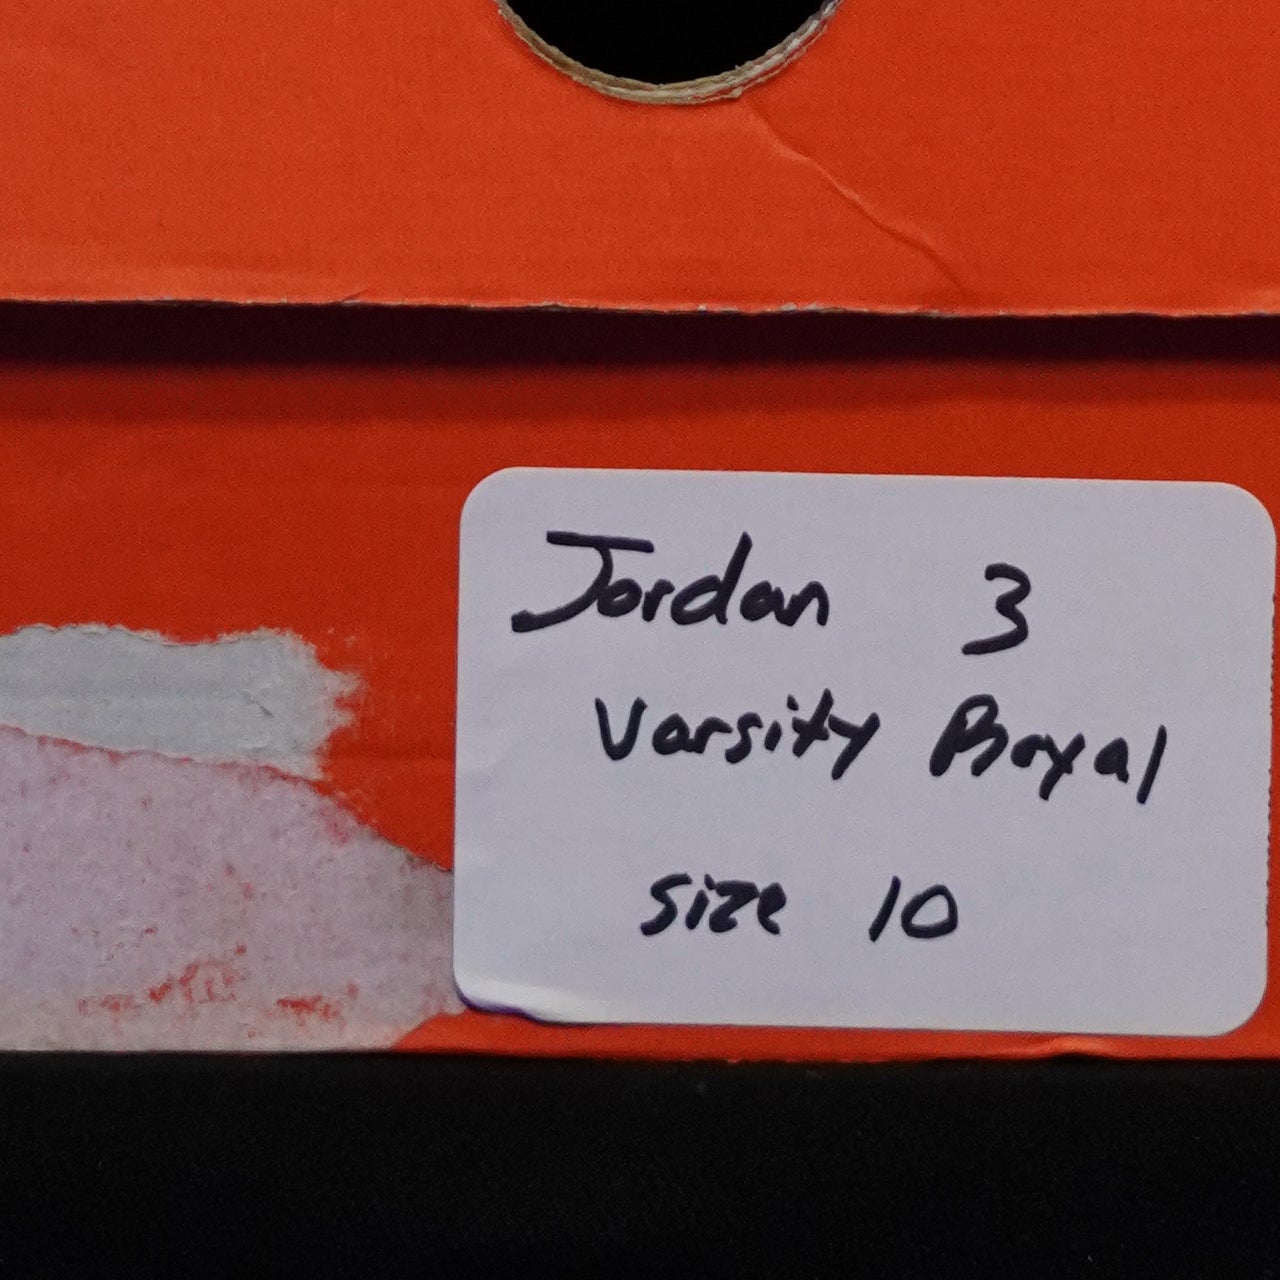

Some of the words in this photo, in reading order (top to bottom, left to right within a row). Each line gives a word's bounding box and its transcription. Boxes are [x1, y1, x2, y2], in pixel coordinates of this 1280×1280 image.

[510, 530, 830, 634] Jordan
[961, 561, 1032, 656] 3
[594, 688, 881, 781] Varsity
[929, 693, 1168, 805] Royal
[868, 875, 959, 943] 10
